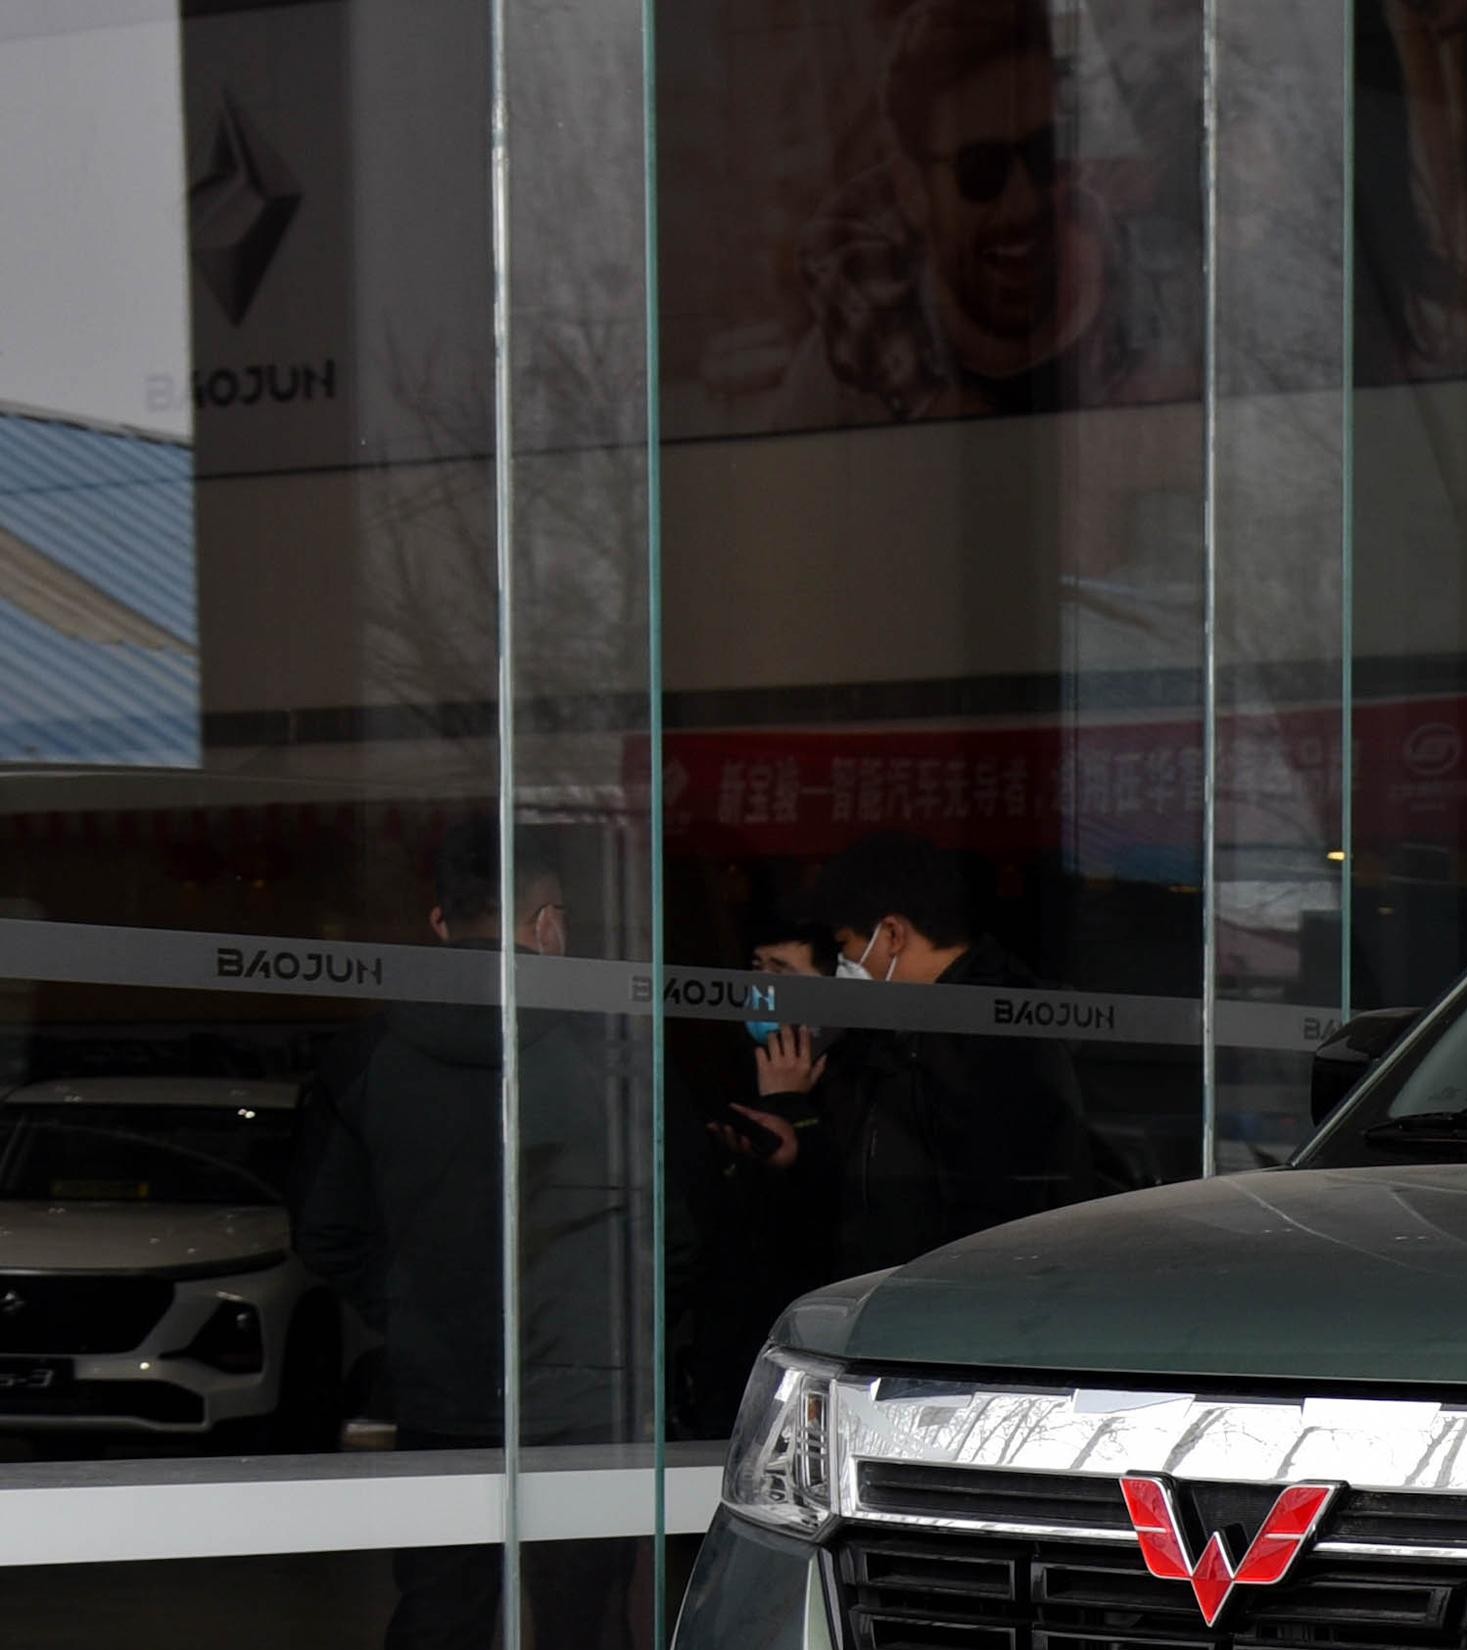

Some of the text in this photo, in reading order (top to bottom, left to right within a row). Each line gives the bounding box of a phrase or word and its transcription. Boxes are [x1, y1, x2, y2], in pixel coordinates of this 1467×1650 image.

[216, 947, 383, 986] BAOJUN
[631, 974, 777, 1012] BAOJUN
[994, 999, 1115, 1030] BAOJUN
